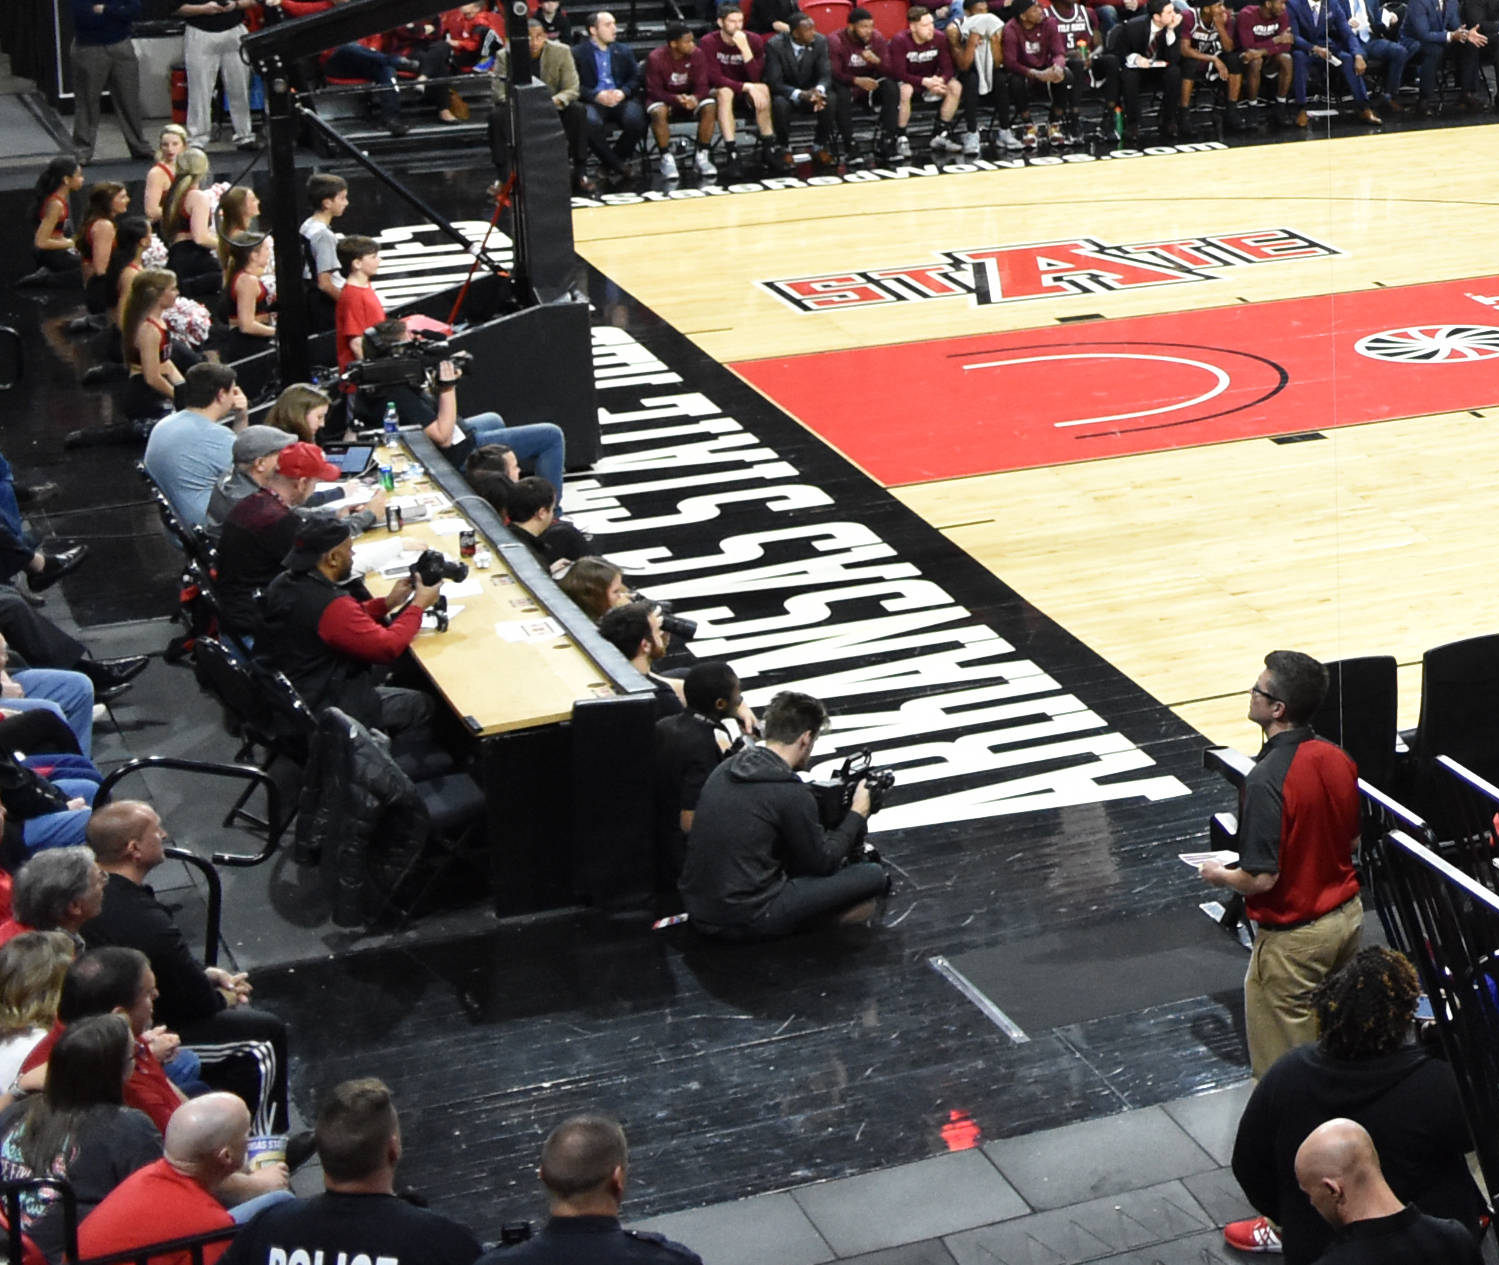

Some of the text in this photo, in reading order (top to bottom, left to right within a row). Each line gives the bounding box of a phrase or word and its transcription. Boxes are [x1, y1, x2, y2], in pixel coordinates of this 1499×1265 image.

[1066, 32, 1075, 49] 5
[752, 225, 1353, 316] STATE
[600, 521, 1192, 834] ARKANSAS
